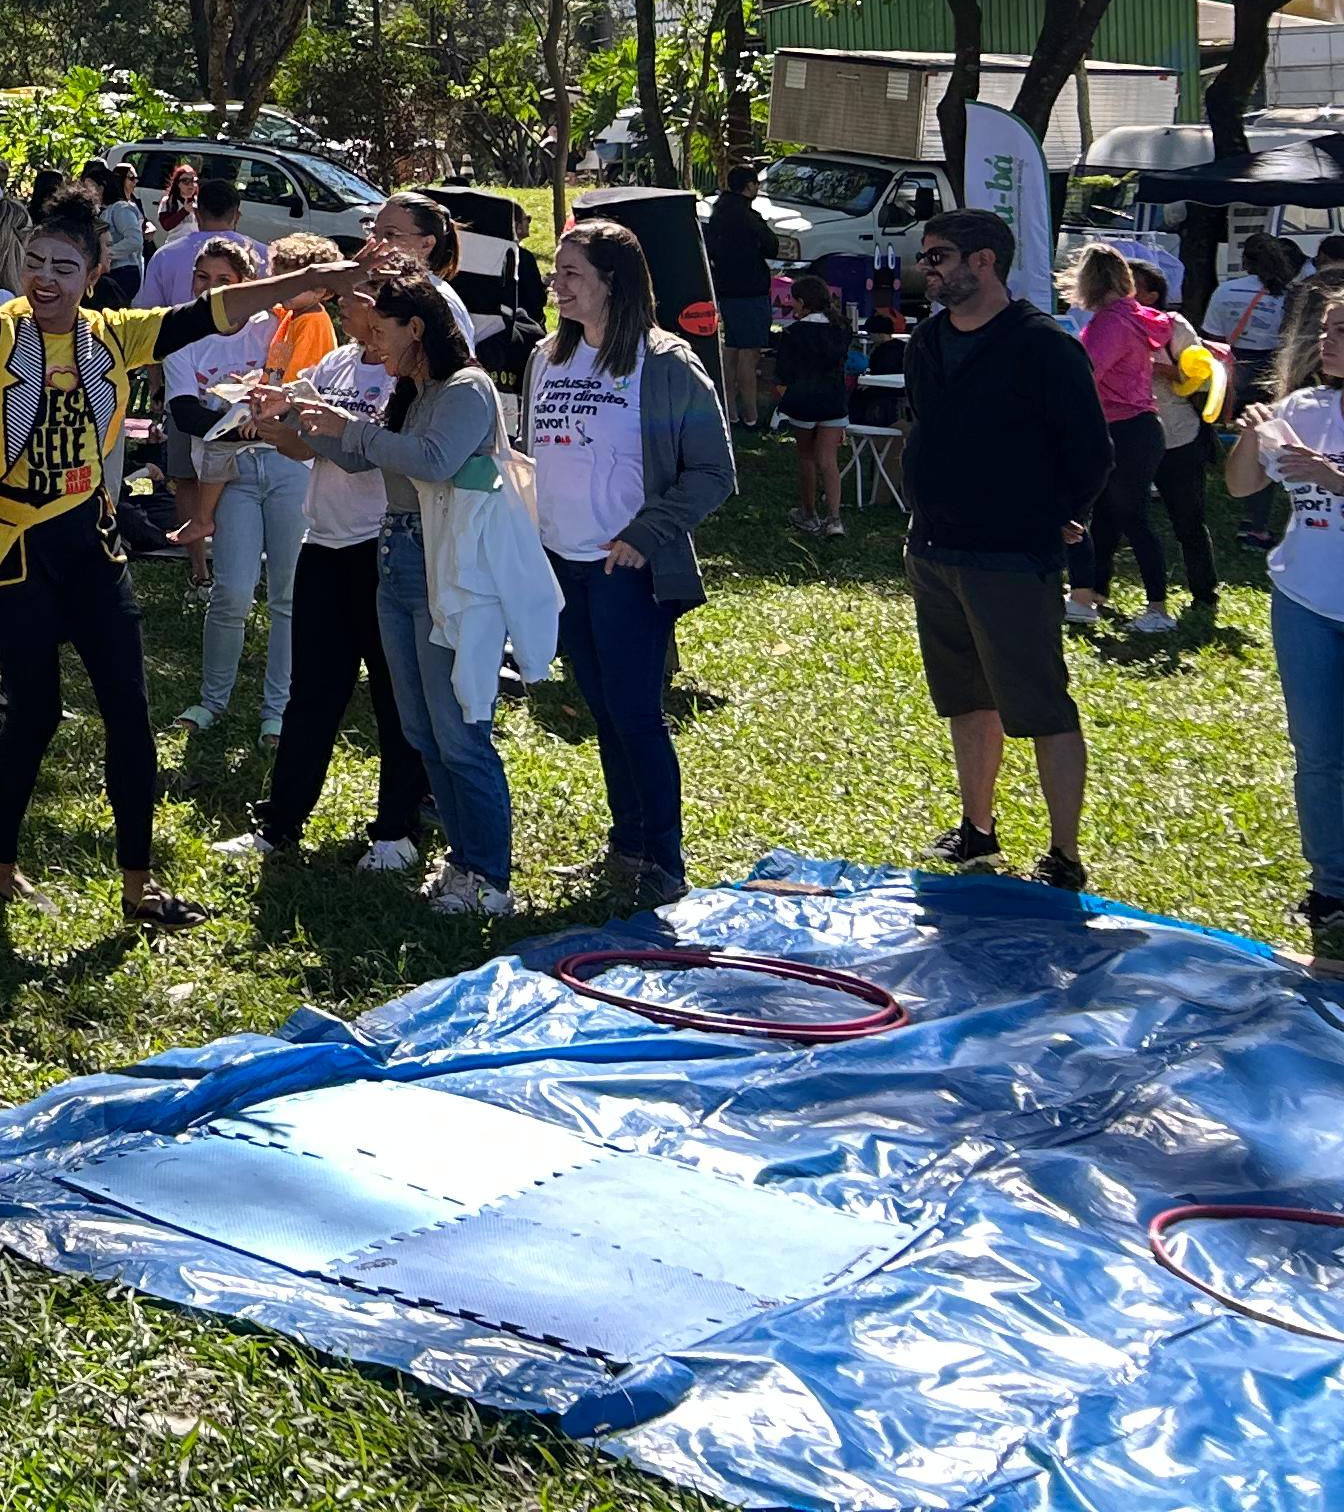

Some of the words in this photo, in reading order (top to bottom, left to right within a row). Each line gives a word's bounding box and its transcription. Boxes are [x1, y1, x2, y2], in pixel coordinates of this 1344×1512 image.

[572, 389, 629, 409] direito,
[571, 404, 598, 416] um
[27, 426, 87, 470] CELE
